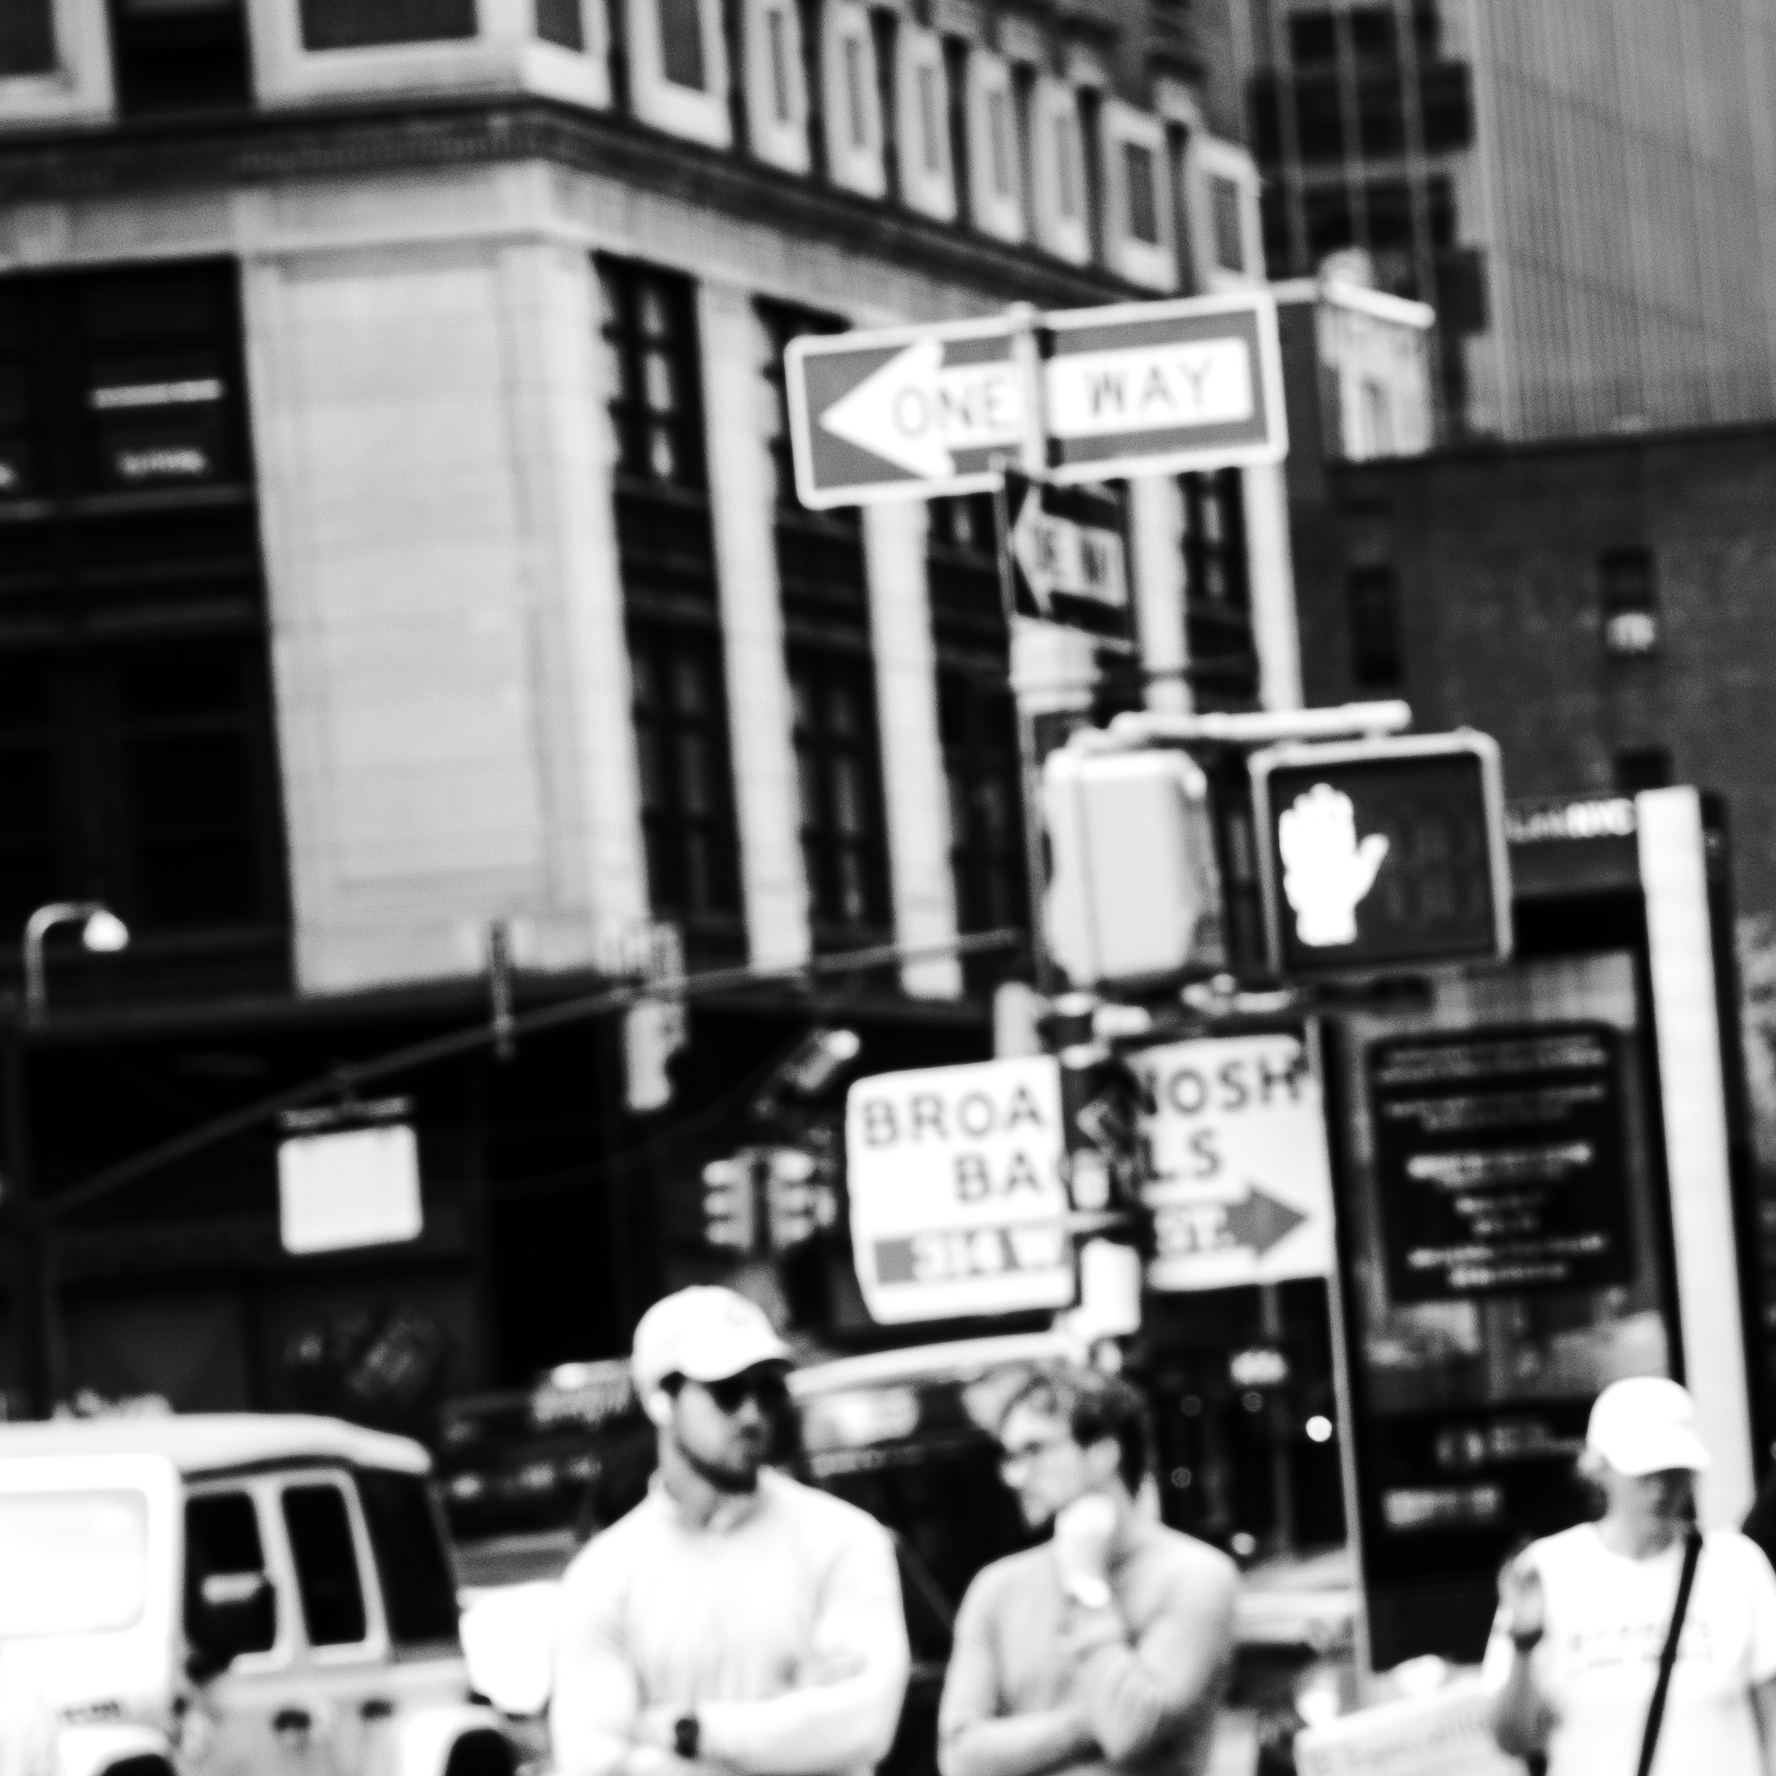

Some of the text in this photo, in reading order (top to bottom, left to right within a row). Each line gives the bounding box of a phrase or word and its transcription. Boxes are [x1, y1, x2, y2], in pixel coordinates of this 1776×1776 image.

[891, 359, 1212, 439] ONE WAY
[862, 1083, 1045, 1147] BROA
